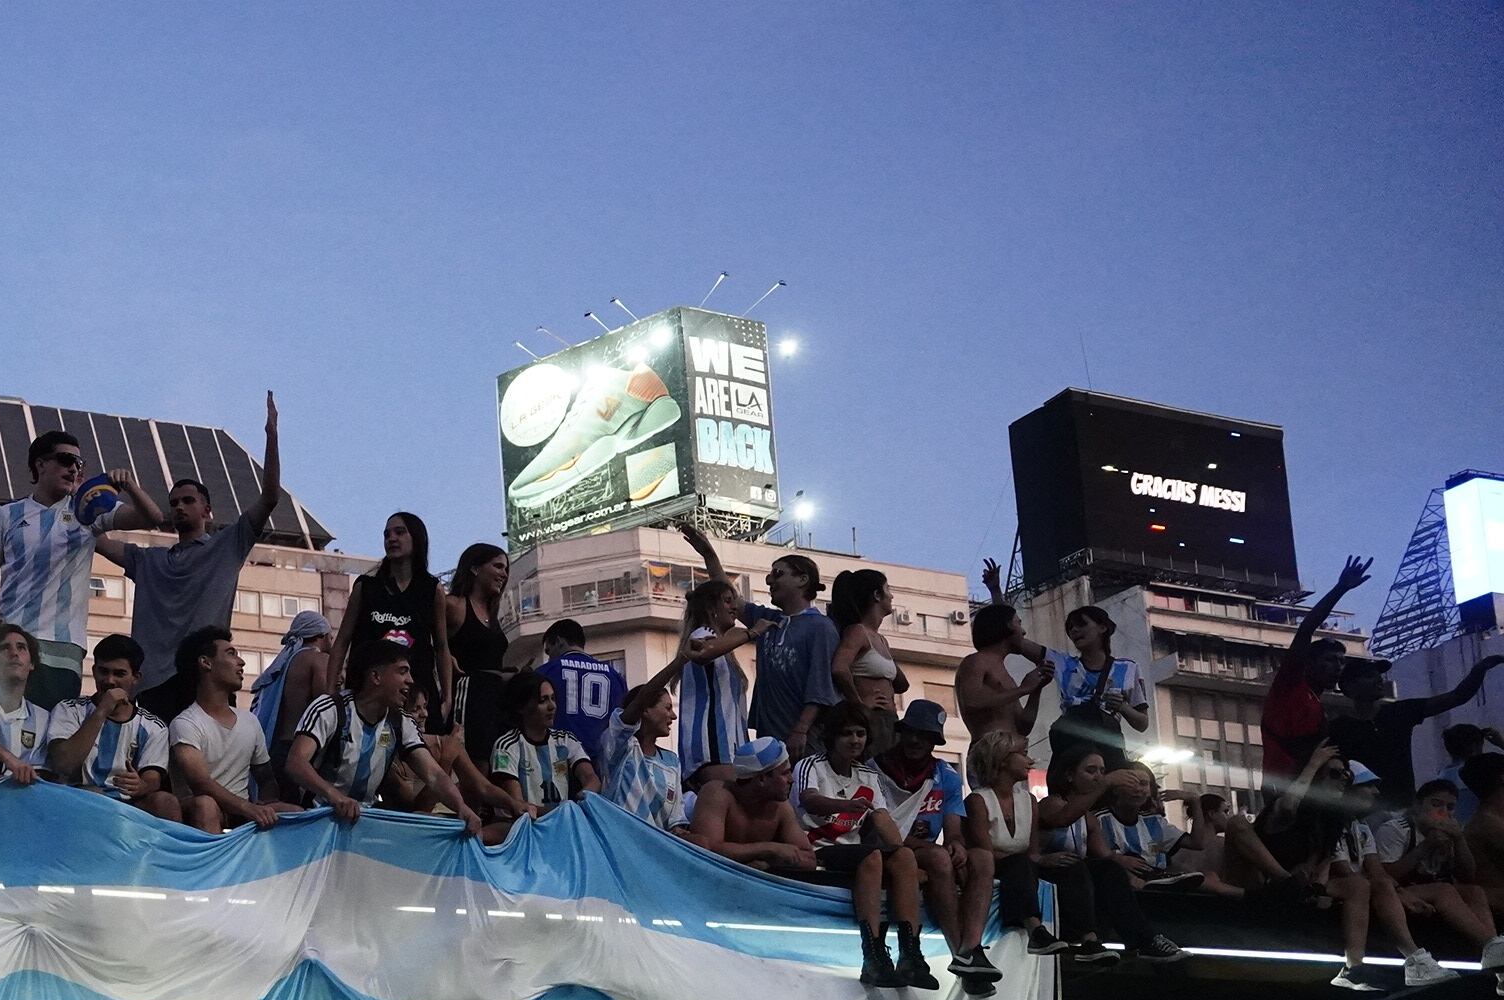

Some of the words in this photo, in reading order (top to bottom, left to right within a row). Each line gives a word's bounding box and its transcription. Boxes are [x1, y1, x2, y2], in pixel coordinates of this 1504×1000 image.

[689, 336, 766, 384] WE
[695, 376, 731, 418] ARE
[735, 389, 762, 411] LA
[696, 417, 775, 475] BACK
[1130, 471, 1198, 504] GRACIAS
[1198, 484, 1247, 513] MESSI
[560, 659, 610, 673] MARADONA
[562, 668, 611, 720] 10
